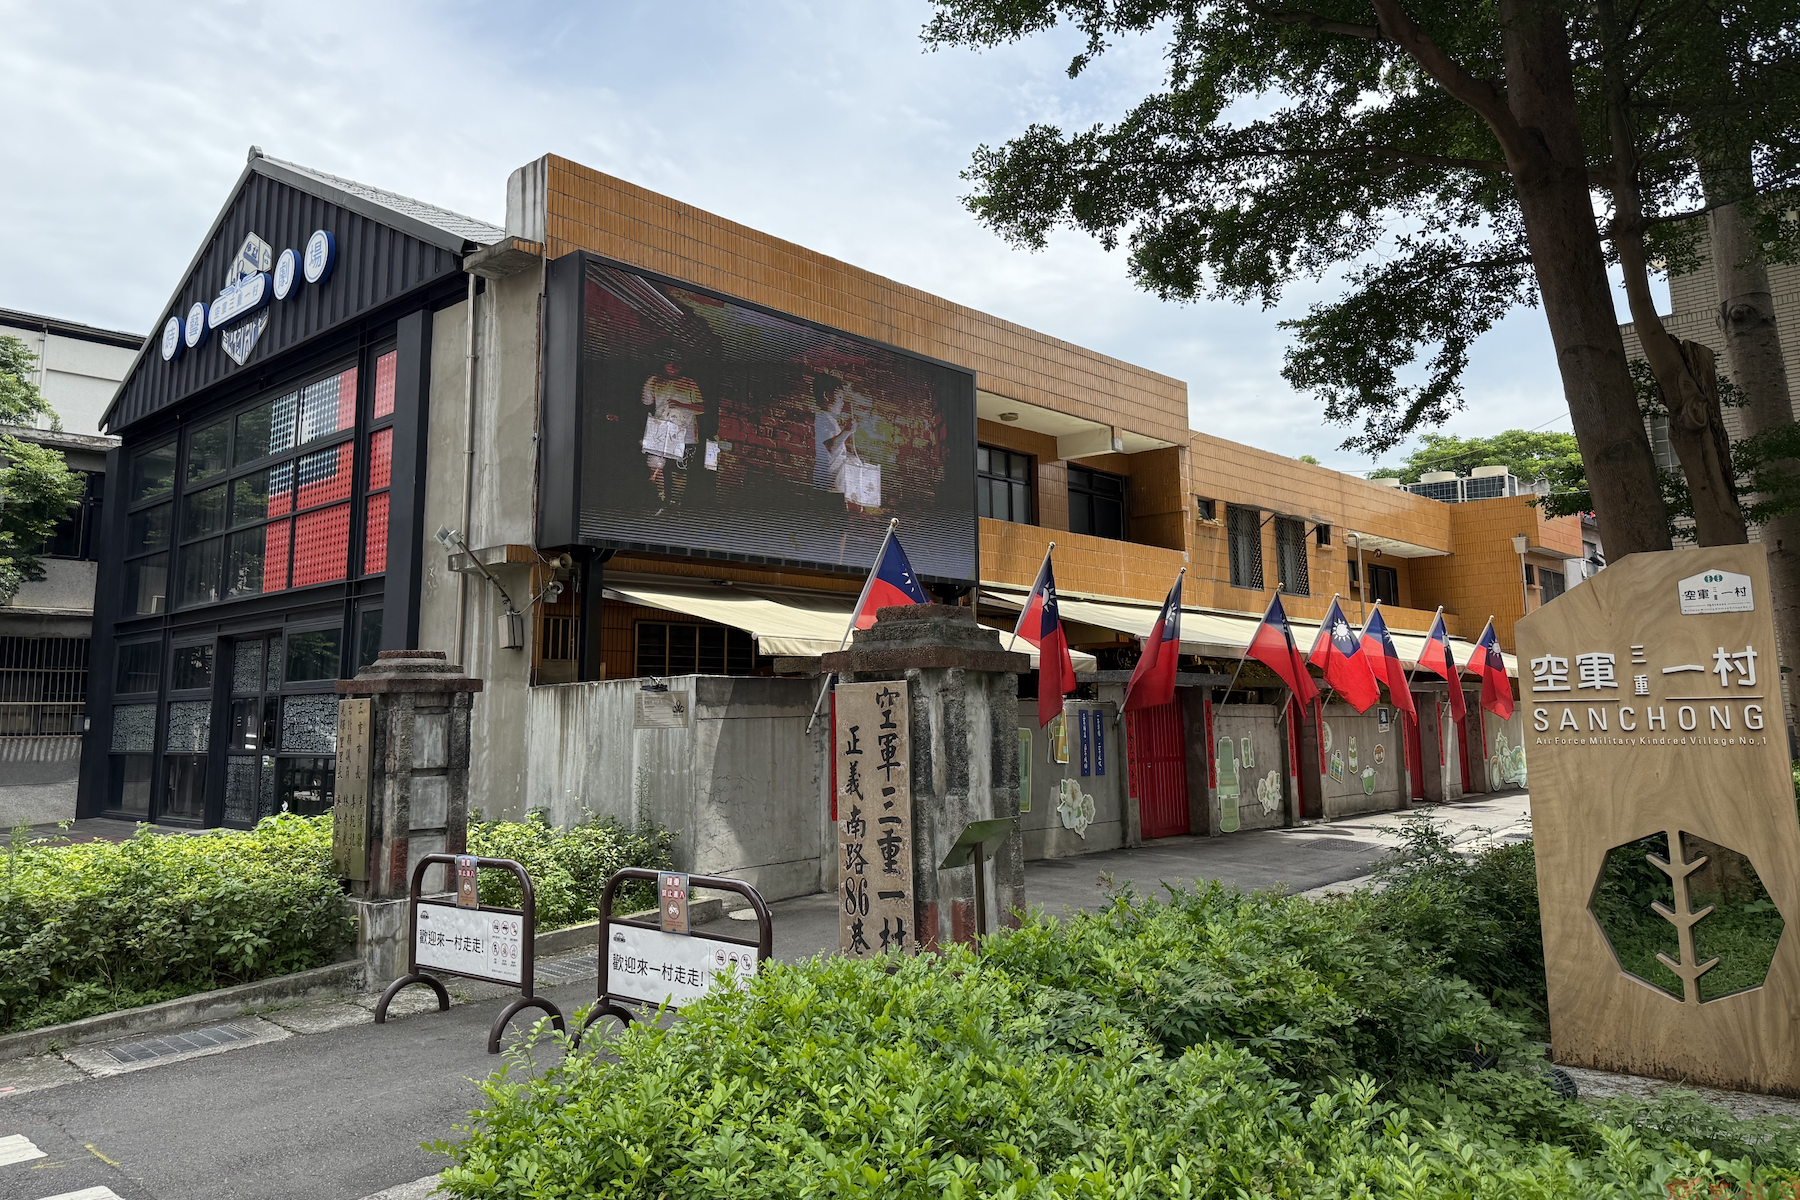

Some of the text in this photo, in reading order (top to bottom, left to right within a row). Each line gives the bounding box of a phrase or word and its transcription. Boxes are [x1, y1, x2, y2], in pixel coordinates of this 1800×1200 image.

[1530, 645, 1758, 696] 空軍三重一村
[1533, 704, 1765, 732] SANCHONG
[1536, 737, 1552, 745] Air
[1554, 737, 1586, 745] Force
[1589, 736, 1636, 747] Military
[1639, 736, 1687, 746] Kindred
[1689, 736, 1735, 747] Village
[876, 686, 907, 952] 空軍三重一村
[844, 725, 871, 955] 正義南路86巷
[419, 929, 484, 954] 歡迎來一村走走!
[612, 953, 704, 987] 歡迎來一村走走!
